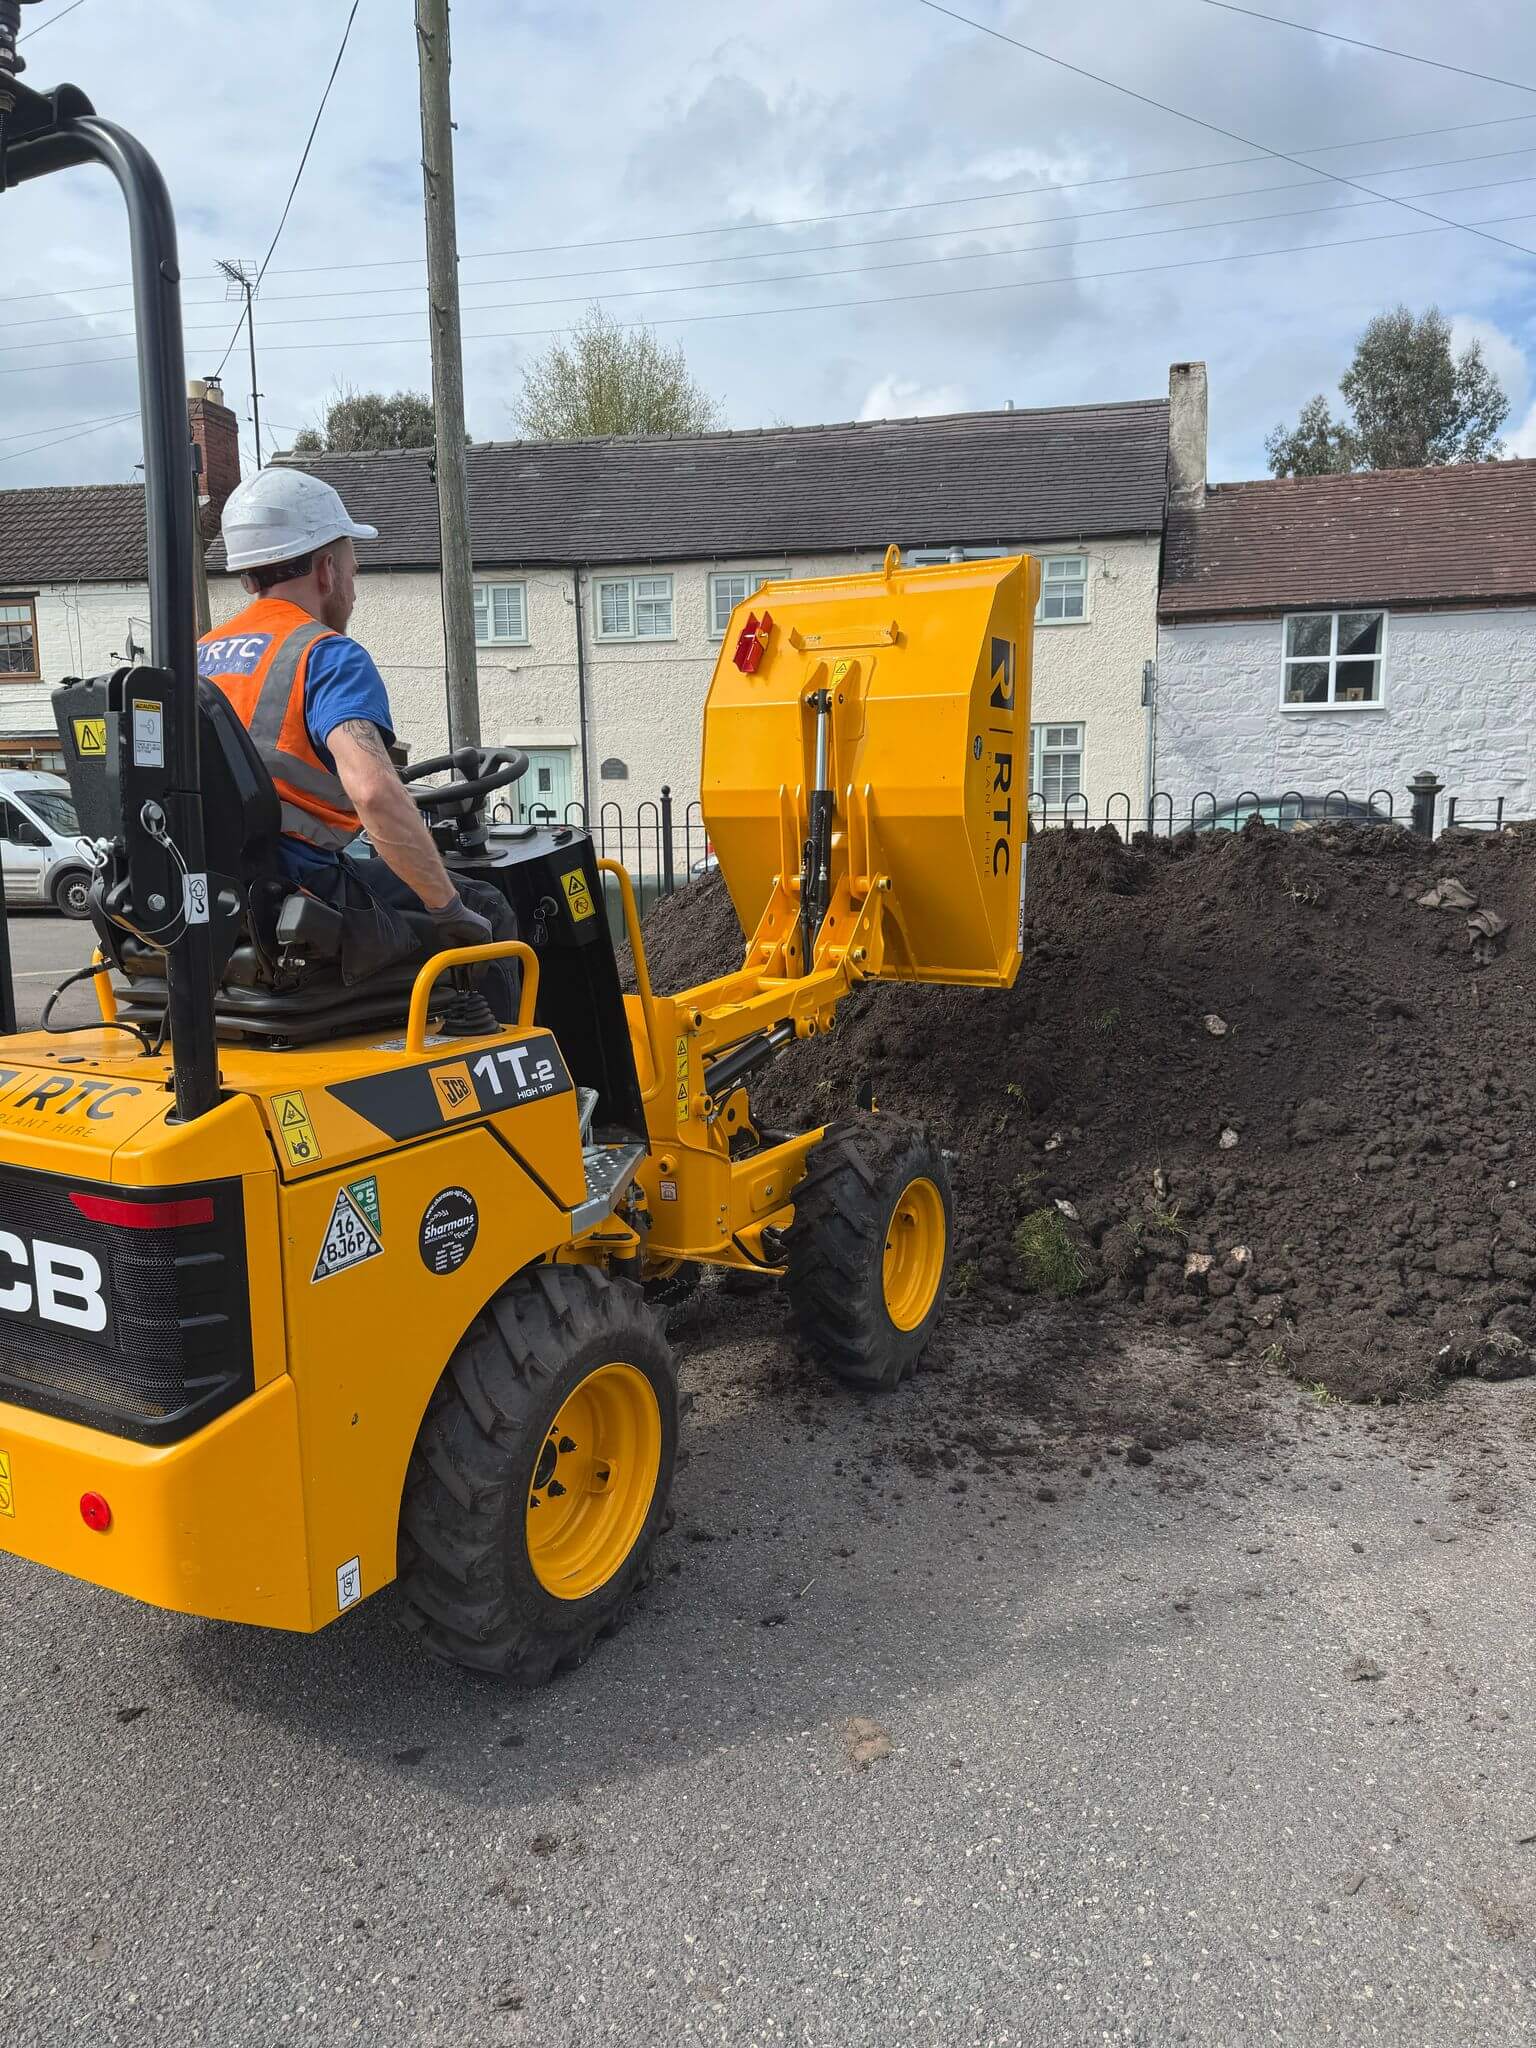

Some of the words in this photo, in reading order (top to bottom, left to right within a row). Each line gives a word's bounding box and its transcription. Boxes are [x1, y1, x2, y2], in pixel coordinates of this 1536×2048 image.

[204, 638, 264, 661] RTC
[993, 752, 1012, 877] RTC
[14, 1076, 142, 1120] RTC
[443, 1079, 470, 1104] JCB
[517, 1088, 539, 1100] HIGH
[540, 1083, 553, 1094] TIP
[52, 1123, 97, 1138] HIRE
[365, 1187, 375, 1203] 5
[336, 1215, 354, 1239] 16
[424, 1214, 475, 1240] Sharmans
[326, 1231, 366, 1263] BJ6P
